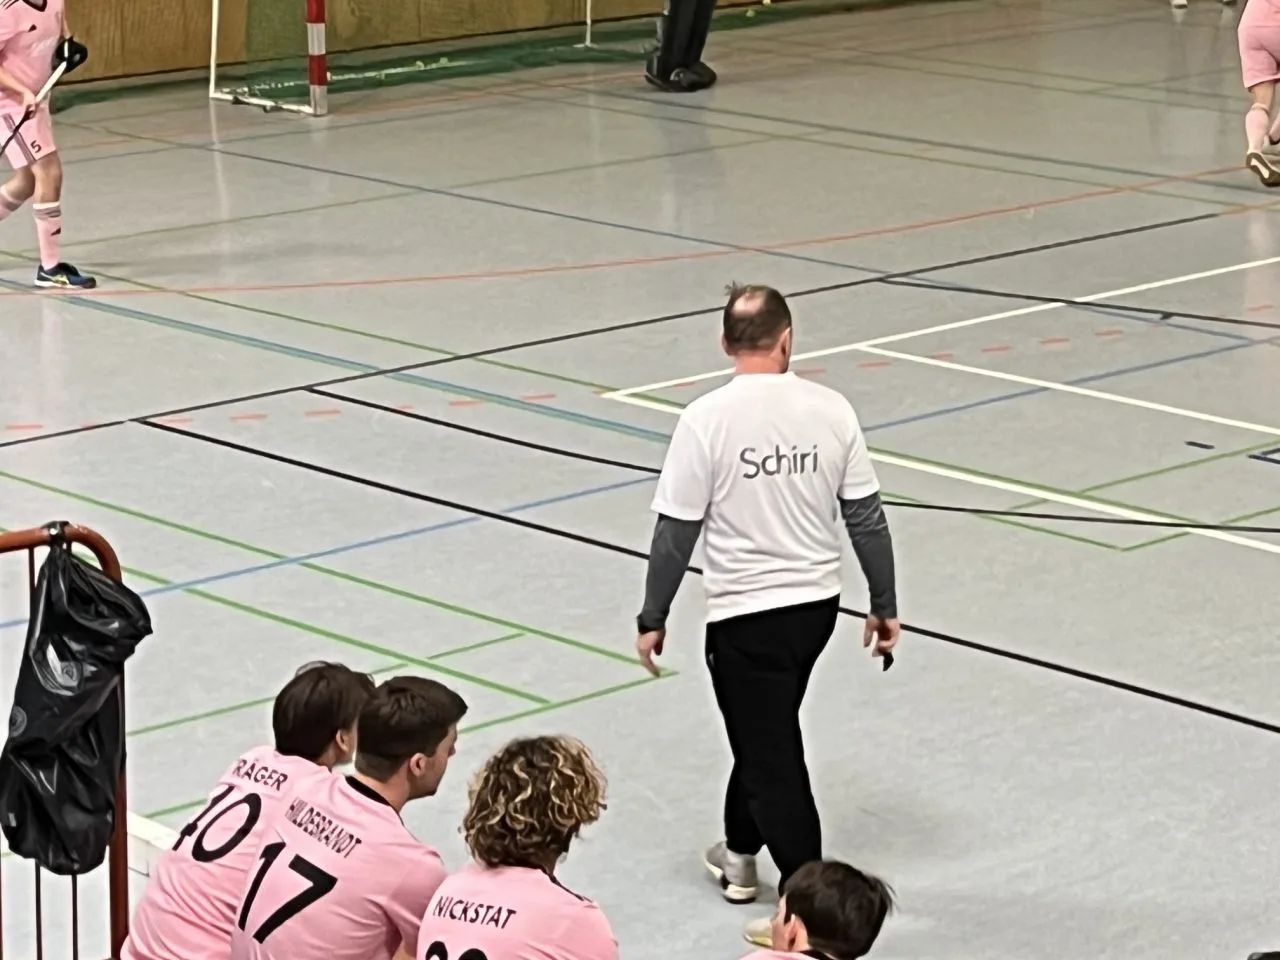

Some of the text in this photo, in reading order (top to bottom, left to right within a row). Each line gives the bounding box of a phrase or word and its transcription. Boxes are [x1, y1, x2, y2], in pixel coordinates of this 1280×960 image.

[30, 139, 42, 154] 5
[740, 444, 818, 479] Schiri
[238, 841, 338, 944] 17
[432, 895, 517, 929] NICKSTAT
